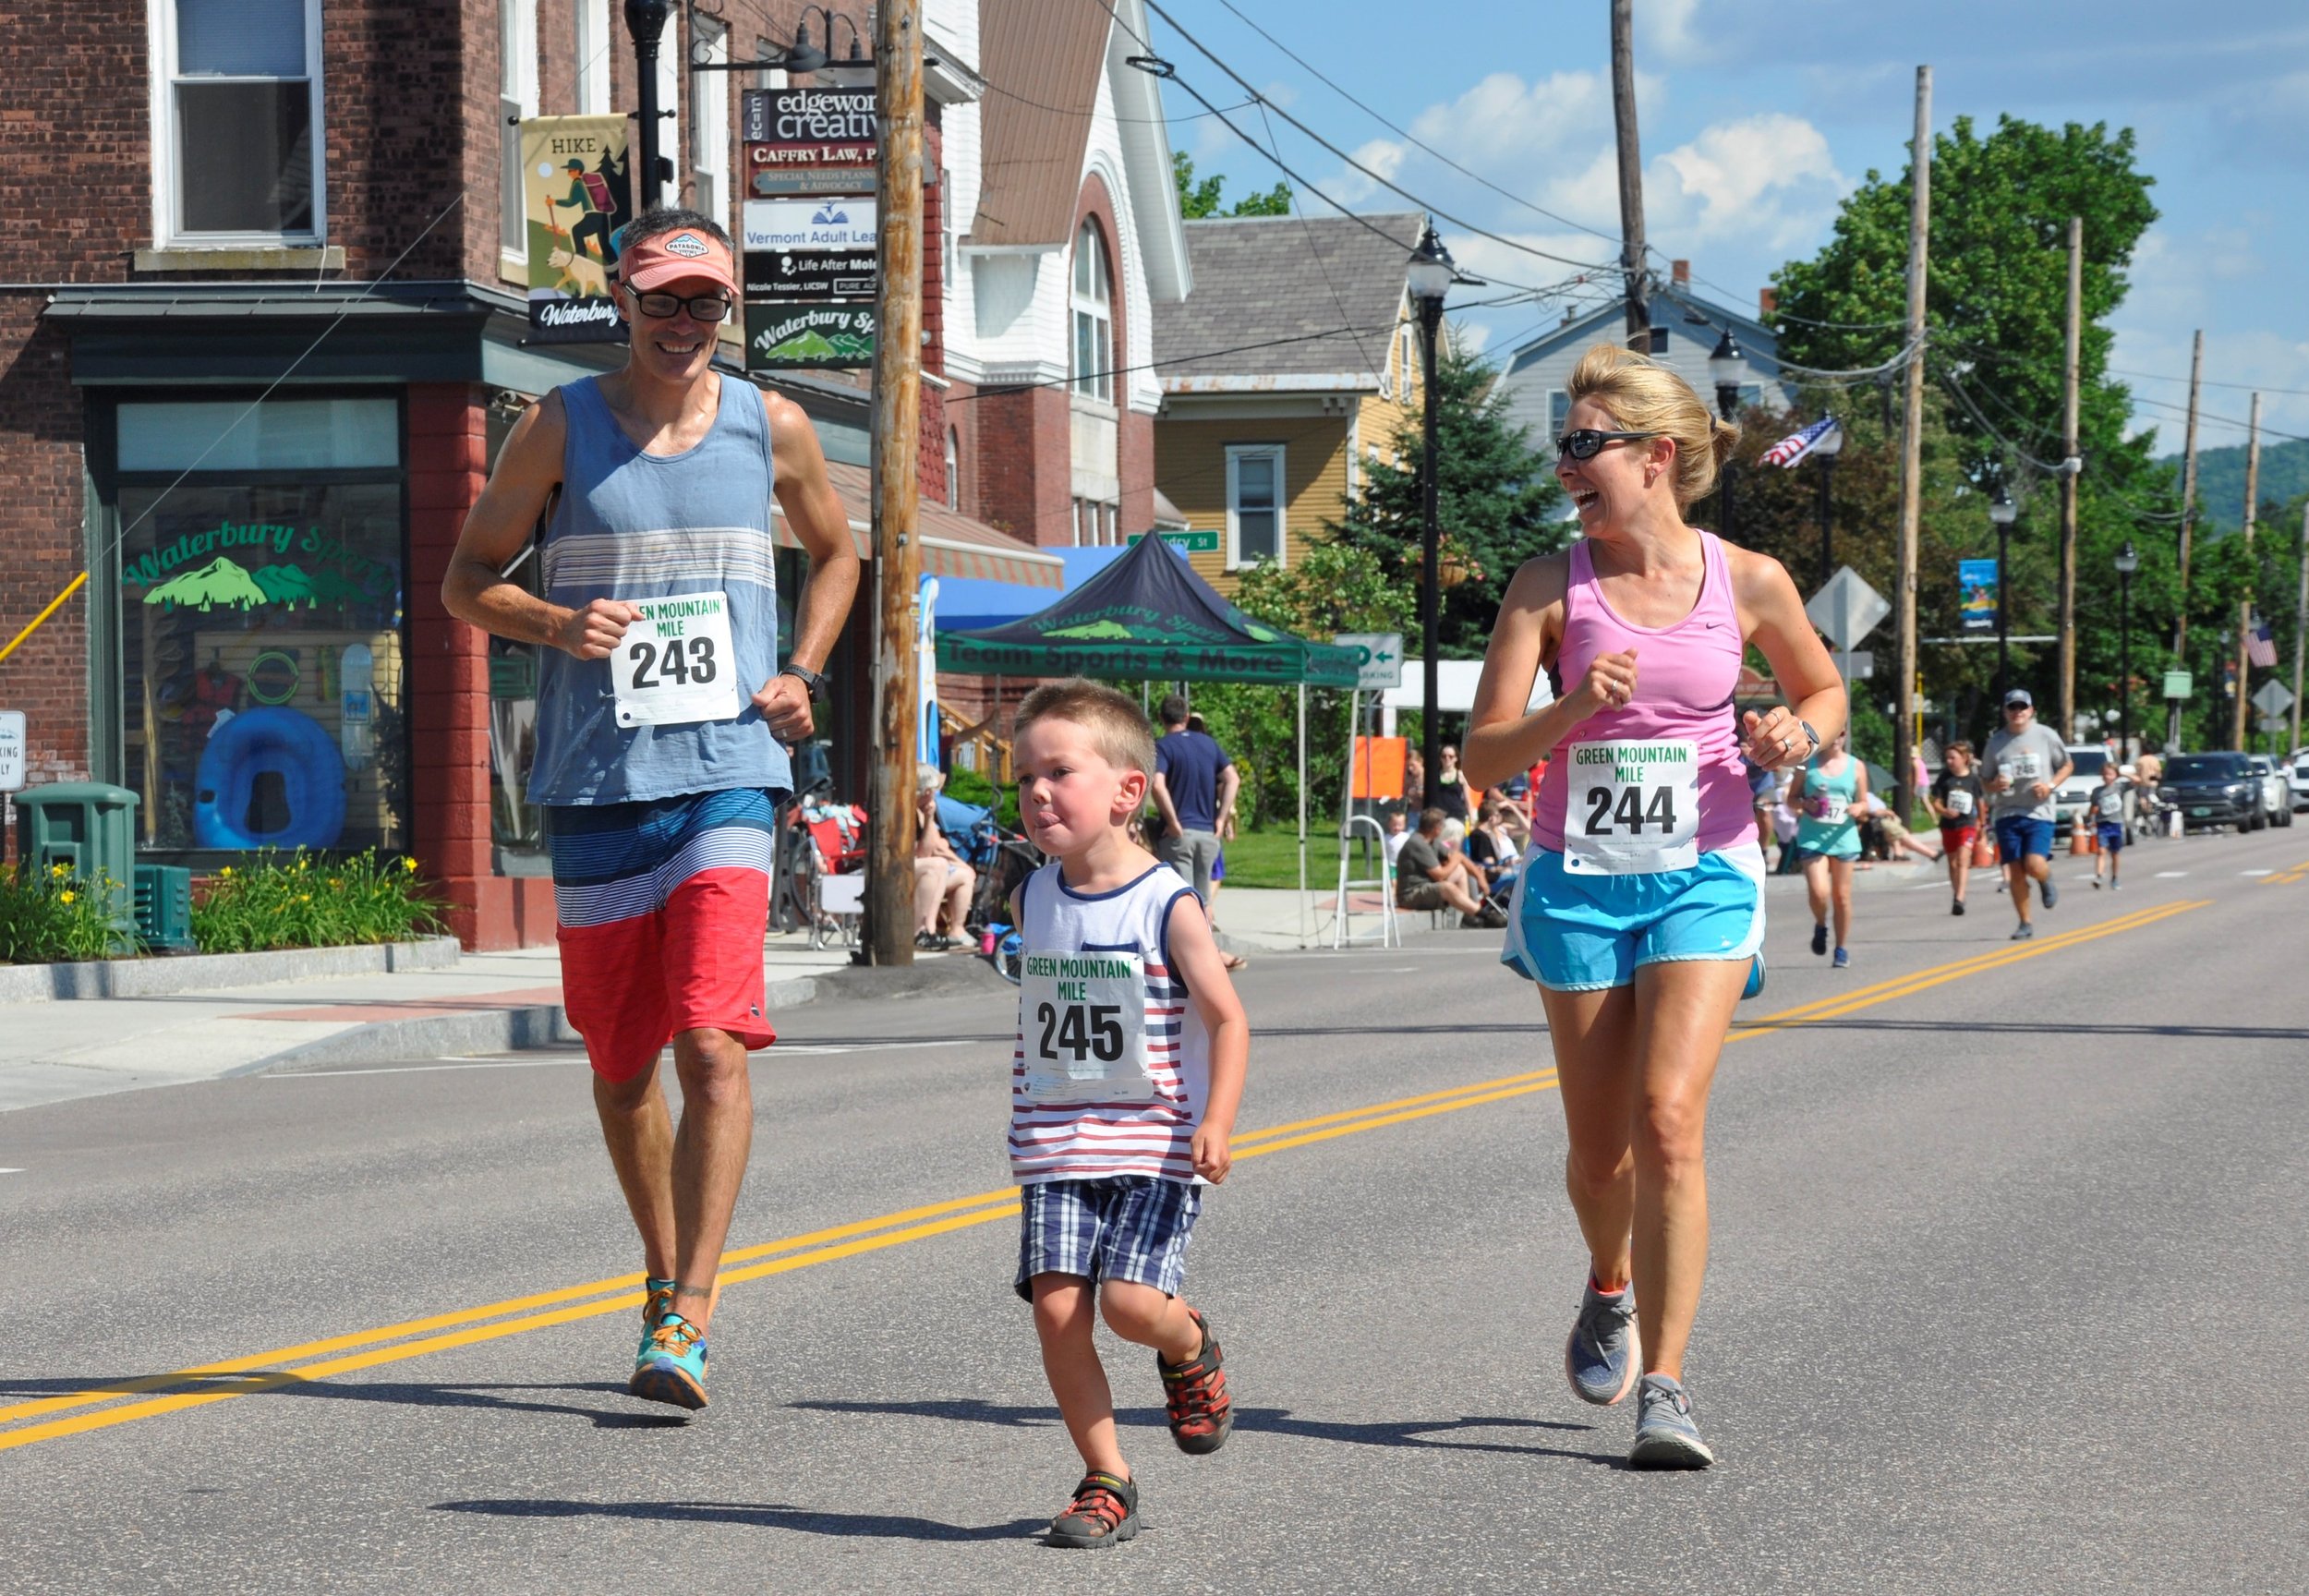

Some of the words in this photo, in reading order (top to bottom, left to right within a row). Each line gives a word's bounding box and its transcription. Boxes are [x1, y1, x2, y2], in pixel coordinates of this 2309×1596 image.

[550, 138, 597, 154] HIKE
[753, 147, 819, 163] CAFFRY
[768, 172, 804, 182] SPECIAL
[799, 181, 809, 190] &
[810, 180, 863, 190] ADVOCACY
[747, 232, 806, 245] Vermont
[810, 231, 848, 244] Adult
[798, 259, 819, 271] Life
[820, 259, 848, 271] After
[746, 282, 772, 292] Nicole
[839, 282, 860, 290] PURE
[539, 298, 620, 327] Waterbury
[754, 309, 852, 350] Waterbury
[1197, 537, 1208, 548] St
[120, 520, 296, 589] Waterbury
[658, 598, 720, 620] MOUNTAIN
[657, 620, 685, 637] MILE
[1029, 605, 1161, 633] Waterbury
[1165, 613, 1229, 643] Sports
[629, 636, 717, 690] 243
[946, 638, 1033, 665] Team
[1045, 647, 1149, 673] Sports
[1161, 648, 1183, 671] &
[1198, 647, 1284, 673] More
[1576, 747, 1614, 766] GREEN
[1618, 746, 1687, 764] MOUNTAIN
[1614, 766, 1644, 783] MILE
[1585, 786, 1677, 836] 244
[1026, 956, 1058, 978] GREEN
[1059, 958, 1131, 979] MOUNTAIN
[1058, 981, 1086, 1001] MILE
[1037, 1001, 1124, 1062] 245
